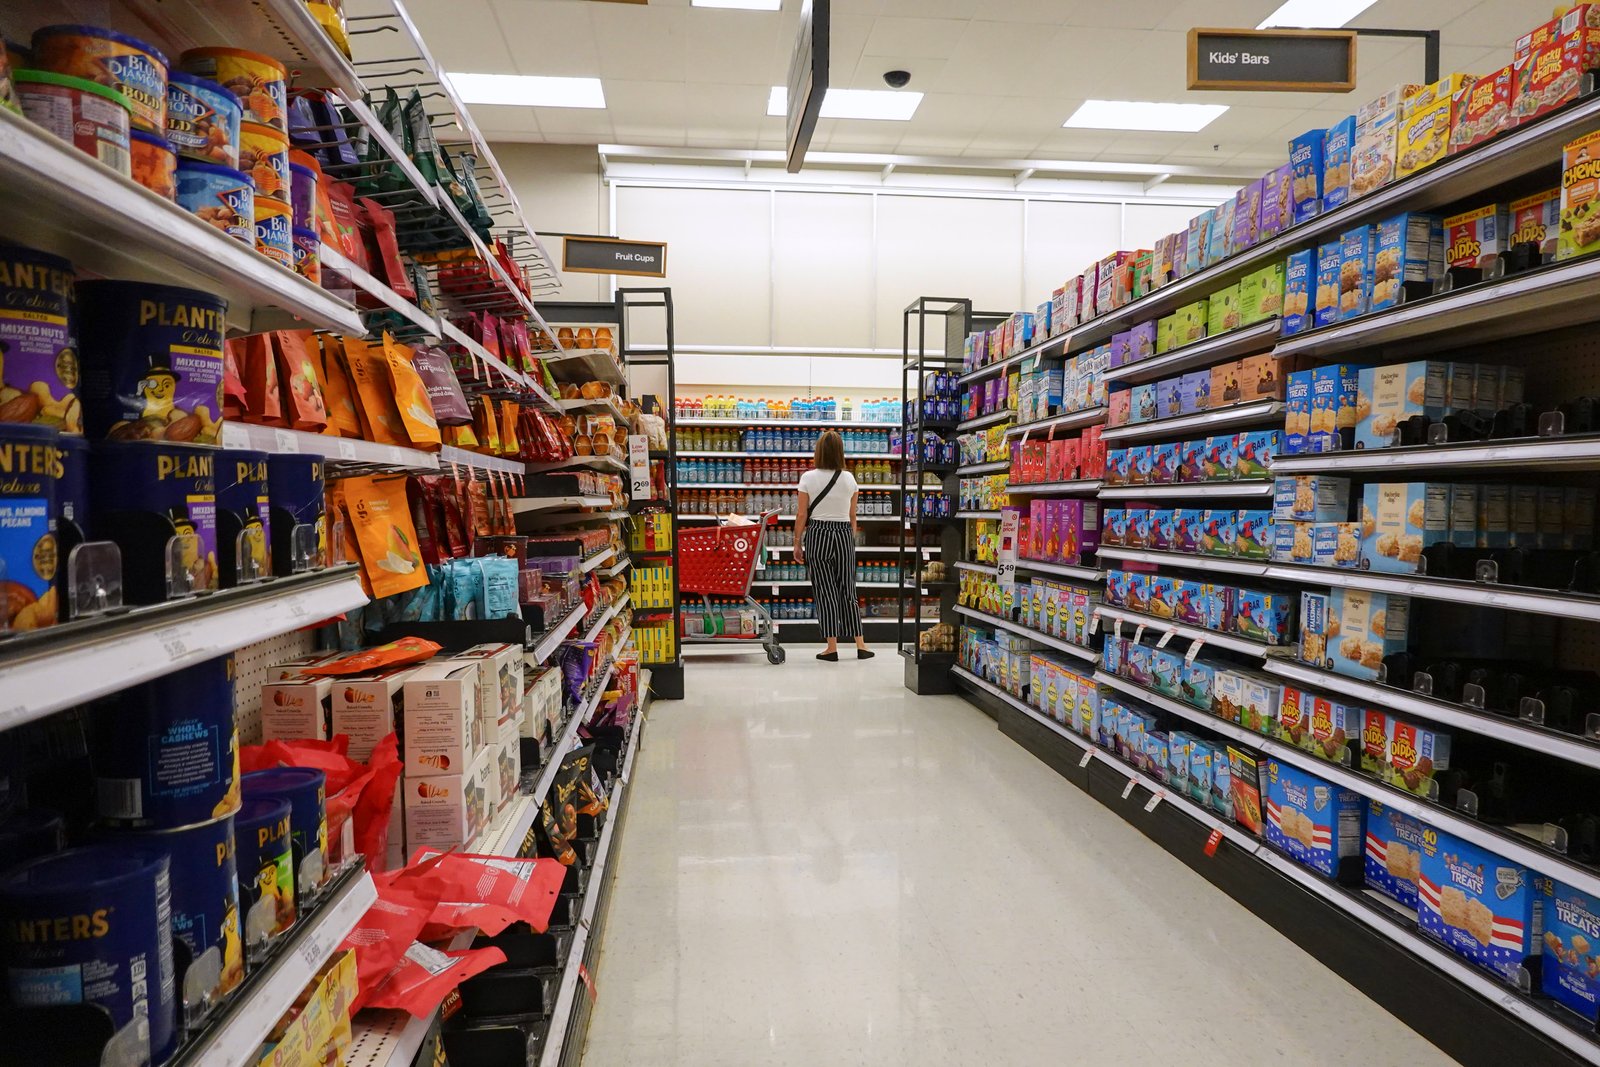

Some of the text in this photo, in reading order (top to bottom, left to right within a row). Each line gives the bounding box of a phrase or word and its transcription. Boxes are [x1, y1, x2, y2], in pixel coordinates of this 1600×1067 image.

[1572, 30, 1581, 41] 8
[1209, 52, 1270, 65] Kids’ Bars
[1502, 67, 1510, 76] 8
[121, 85, 160, 110] BOLD
[1328, 139, 1347, 155] TREATS
[1292, 150, 1312, 166] TREATS
[1445, 214, 1464, 226] VALUE
[1380, 236, 1399, 247] TREATS
[615, 252, 655, 263] Fruit Cups
[1344, 247, 1362, 259] TREATS
[1288, 269, 1306, 280] TREATS
[0, 323, 65, 339] MIXED NUTS
[176, 358, 204, 370] MIXED
[1289, 389, 1307, 398] TREATS
[1315, 384, 1333, 394] TREATS
[168, 723, 203, 735] WHOLE
[161, 729, 208, 744] CASHEWS
[1363, 730, 1386, 749] DIPPS
[1391, 741, 1417, 763] DIPPS
[1269, 762, 1278, 774] 40
[1287, 794, 1307, 810] TREATS
[1423, 829, 1437, 845] 40
[1451, 870, 1483, 895] TREATS
[1556, 898, 1570, 910] RICE
[1556, 906, 1600, 939] TREATS
